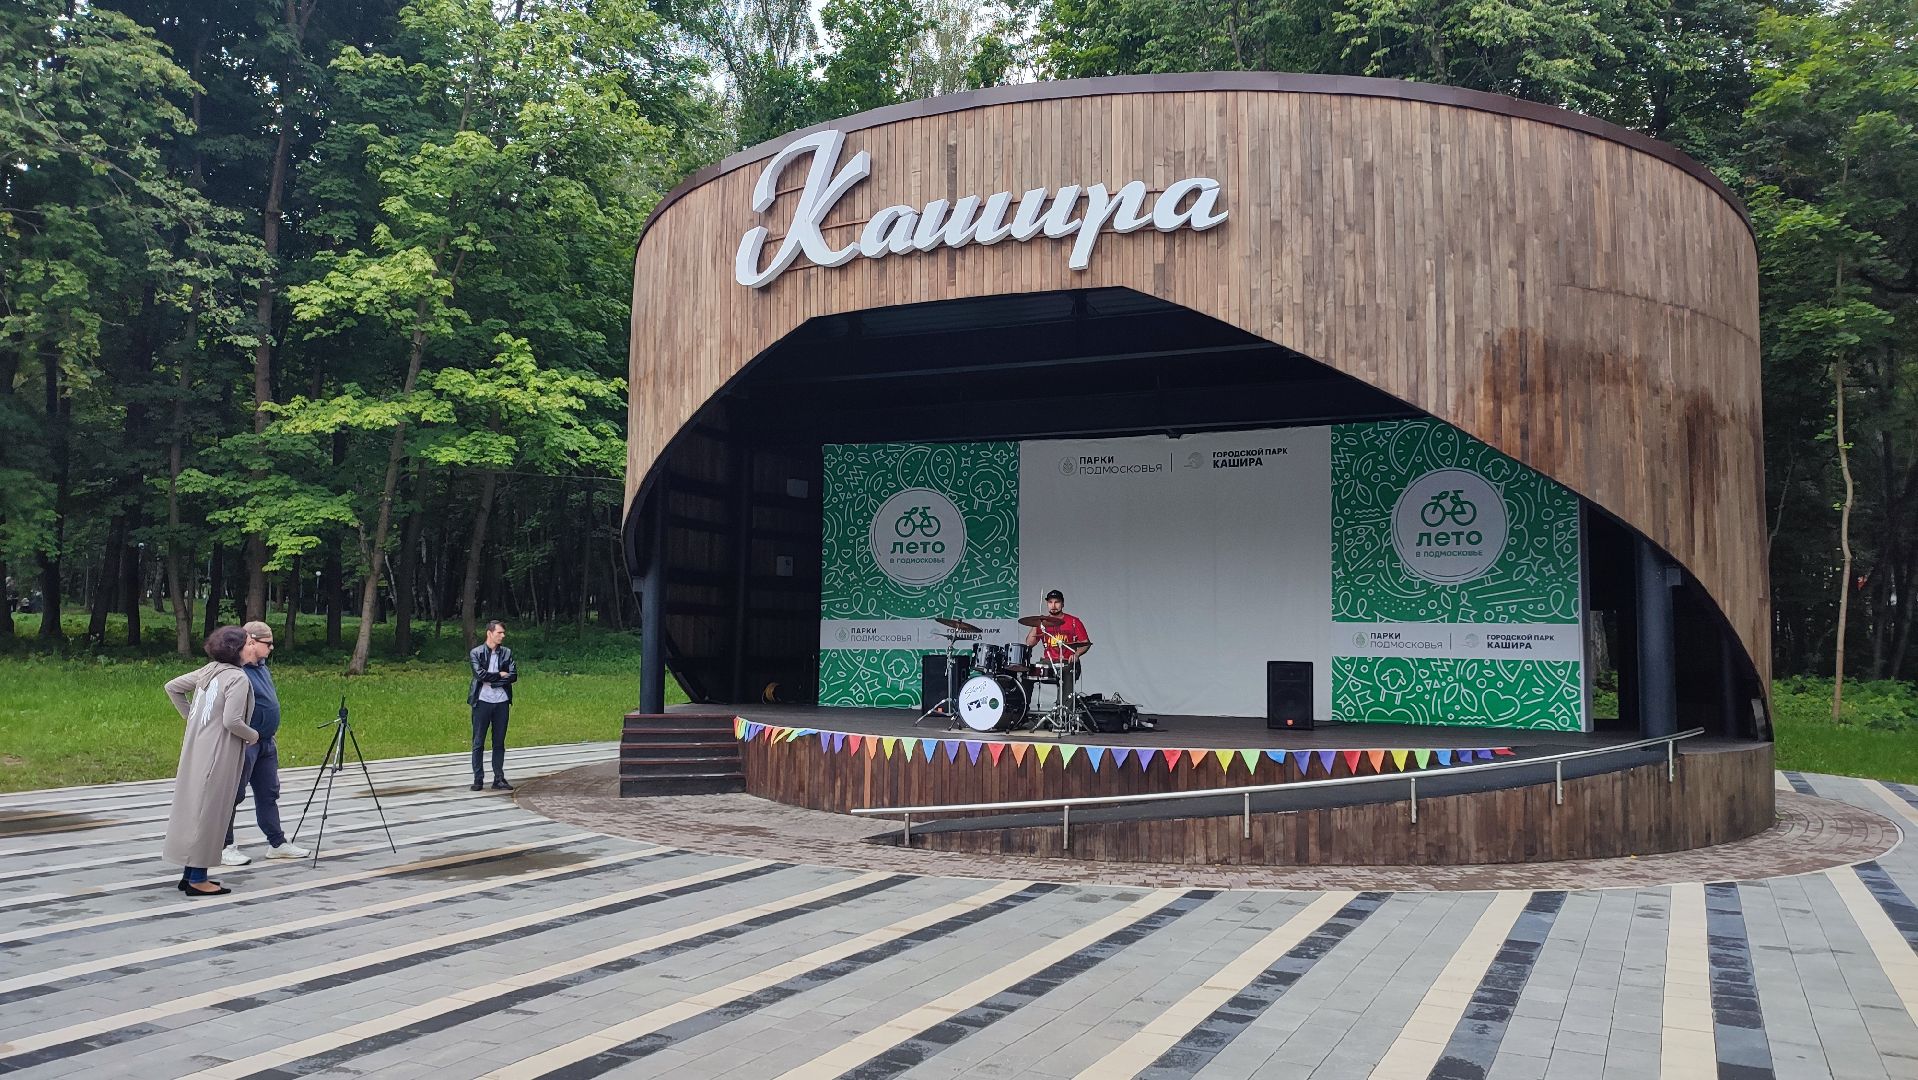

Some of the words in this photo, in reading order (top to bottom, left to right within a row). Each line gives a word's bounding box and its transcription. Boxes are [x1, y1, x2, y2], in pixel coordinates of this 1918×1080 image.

[735, 129, 1229, 289] Кашира
[1212, 448, 1264, 458] ГОРОДСКОЙ
[1265, 447, 1288, 456] ПАРК
[1079, 455, 1114, 465] ПАРКИ
[1212, 457, 1263, 469] КАШИРА
[1079, 463, 1163, 475] ПОДМОСКОВЬЯ
[850, 634, 912, 642] ПОДМОСКОВЬЯ
[1370, 632, 1401, 640] ПАРКИ
[1486, 633, 1533, 641] ГОРОДСКОЙ
[1370, 640, 1443, 650] ПОДМОСКОВЬЯ
[1487, 641, 1532, 650] КАШИРА
